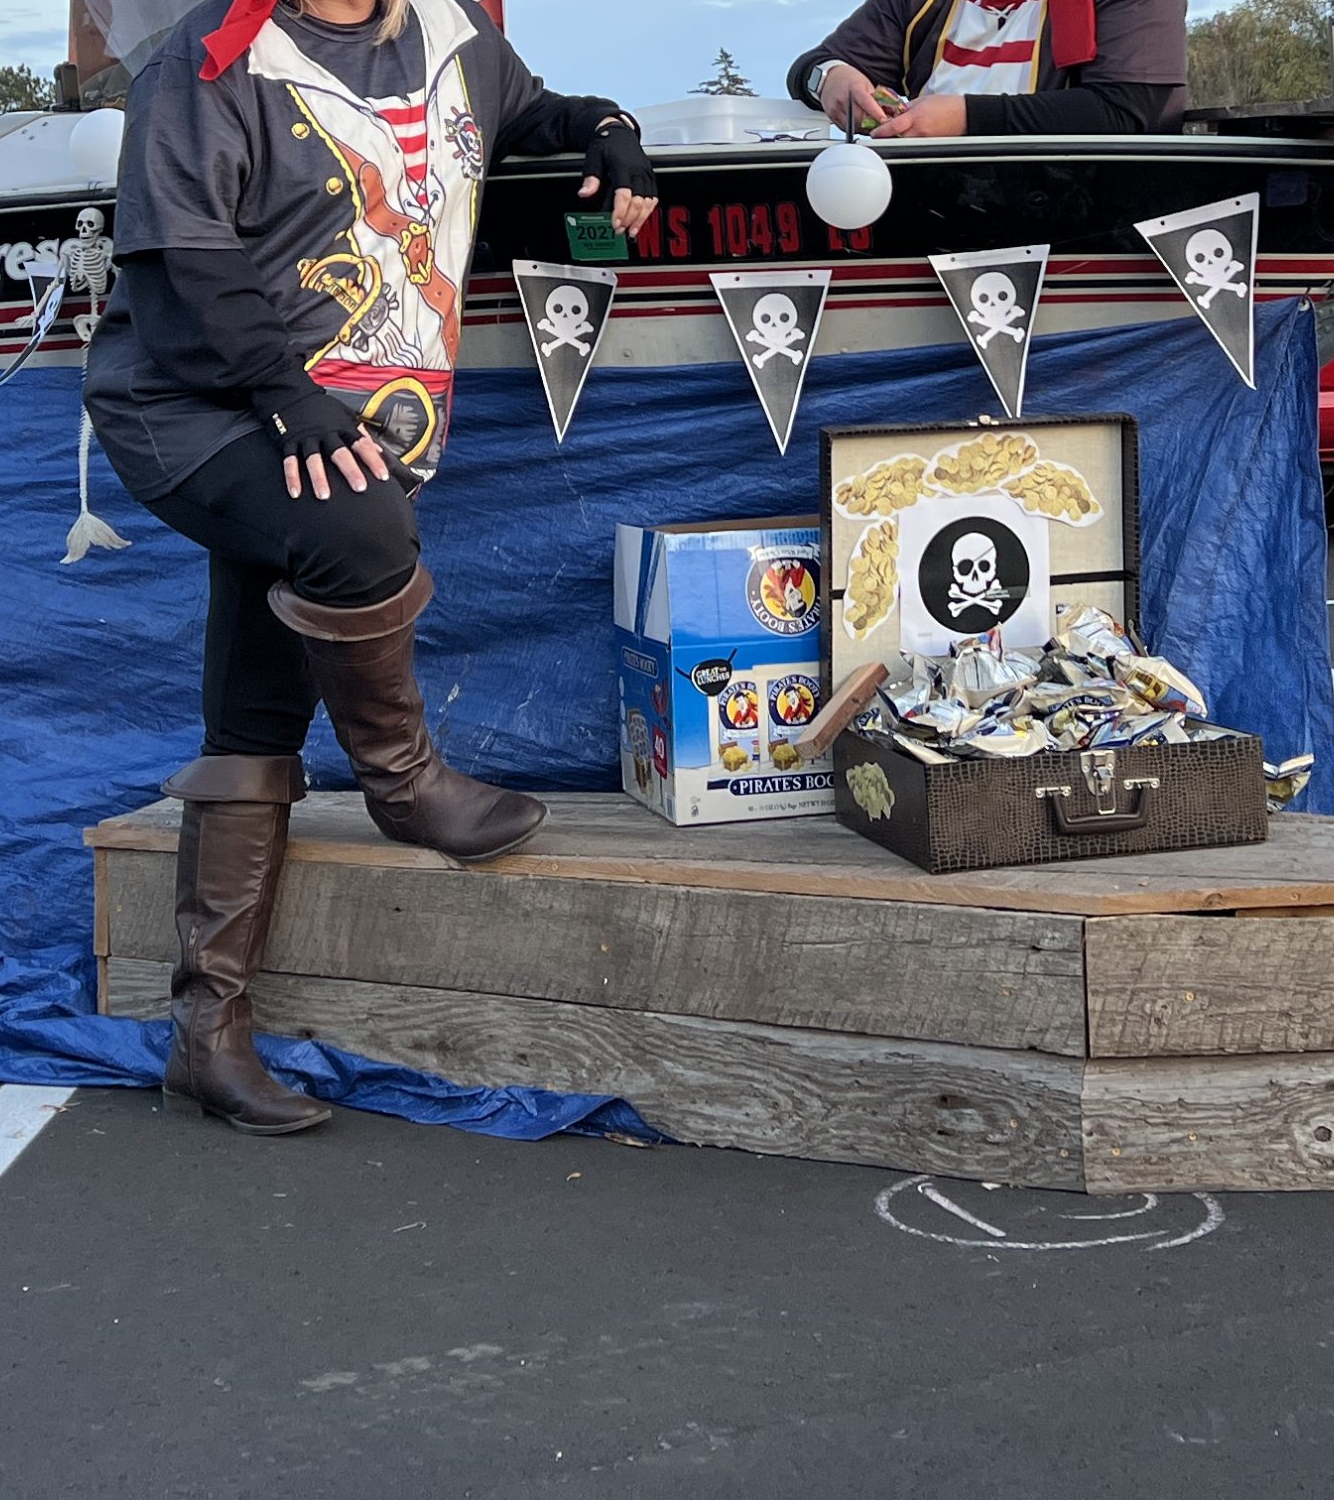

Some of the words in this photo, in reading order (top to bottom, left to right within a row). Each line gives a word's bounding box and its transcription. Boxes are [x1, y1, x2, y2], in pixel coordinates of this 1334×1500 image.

[708, 202, 800, 256] 1049
[751, 598, 785, 632] BOOTY
[654, 734, 665, 760] 40
[739, 776, 802, 794] PIRATE'S
[806, 774, 835, 789] BOO
